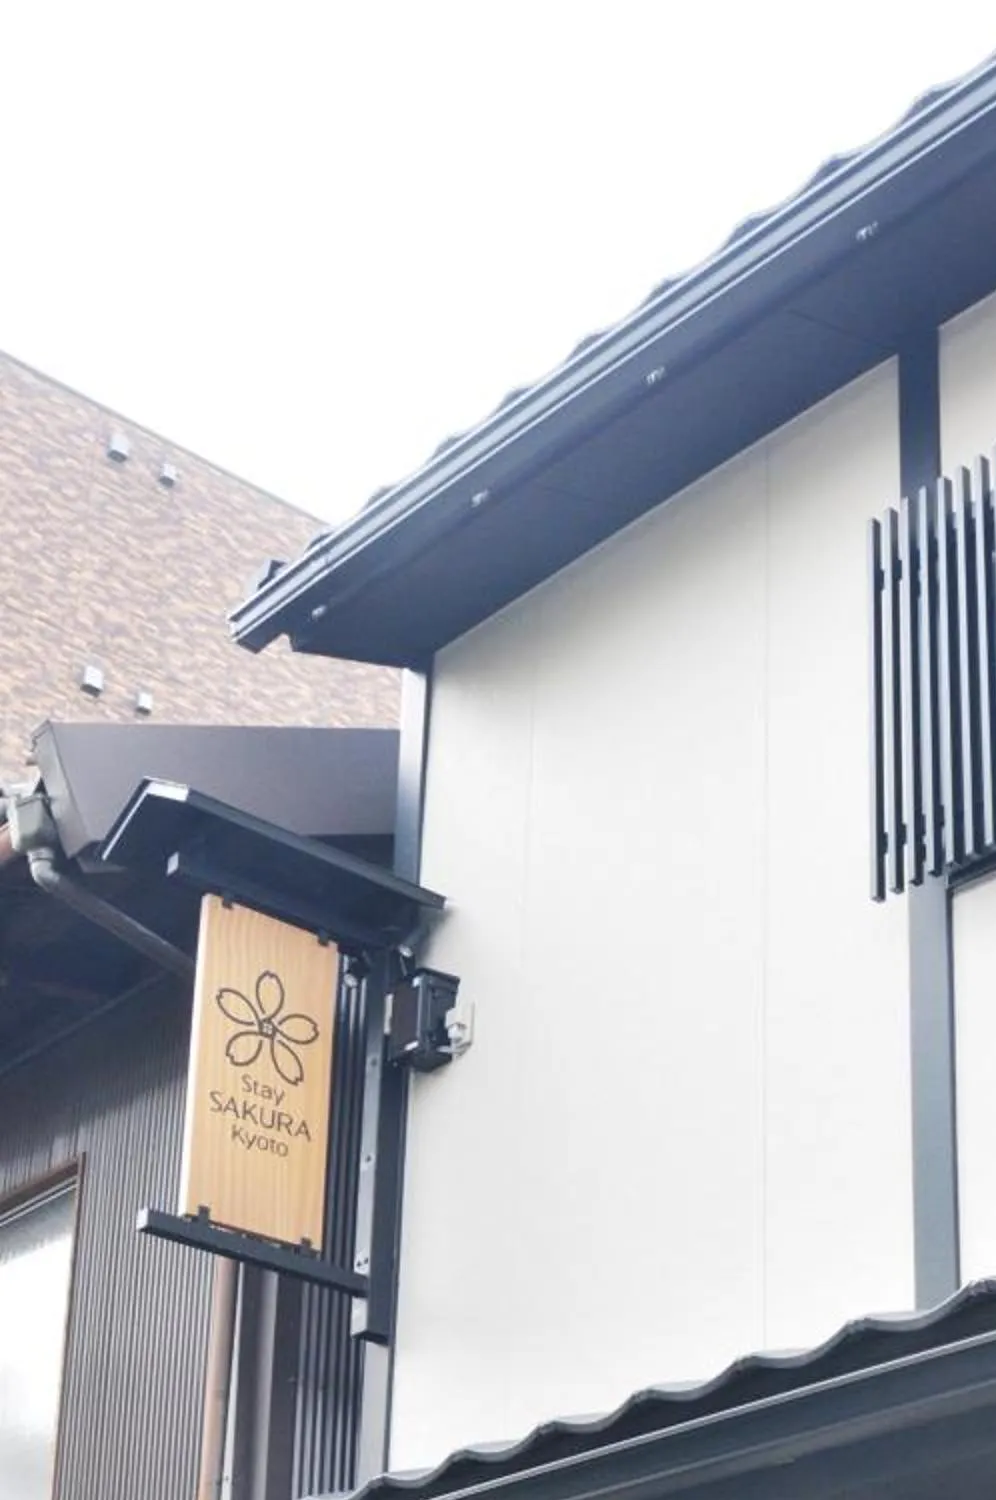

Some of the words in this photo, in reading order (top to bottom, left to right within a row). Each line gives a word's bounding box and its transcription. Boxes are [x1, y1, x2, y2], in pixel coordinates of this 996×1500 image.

[241, 1073, 285, 1106] Stay
[209, 1090, 311, 1142] SAKURA
[231, 1124, 289, 1157] Kyoto
